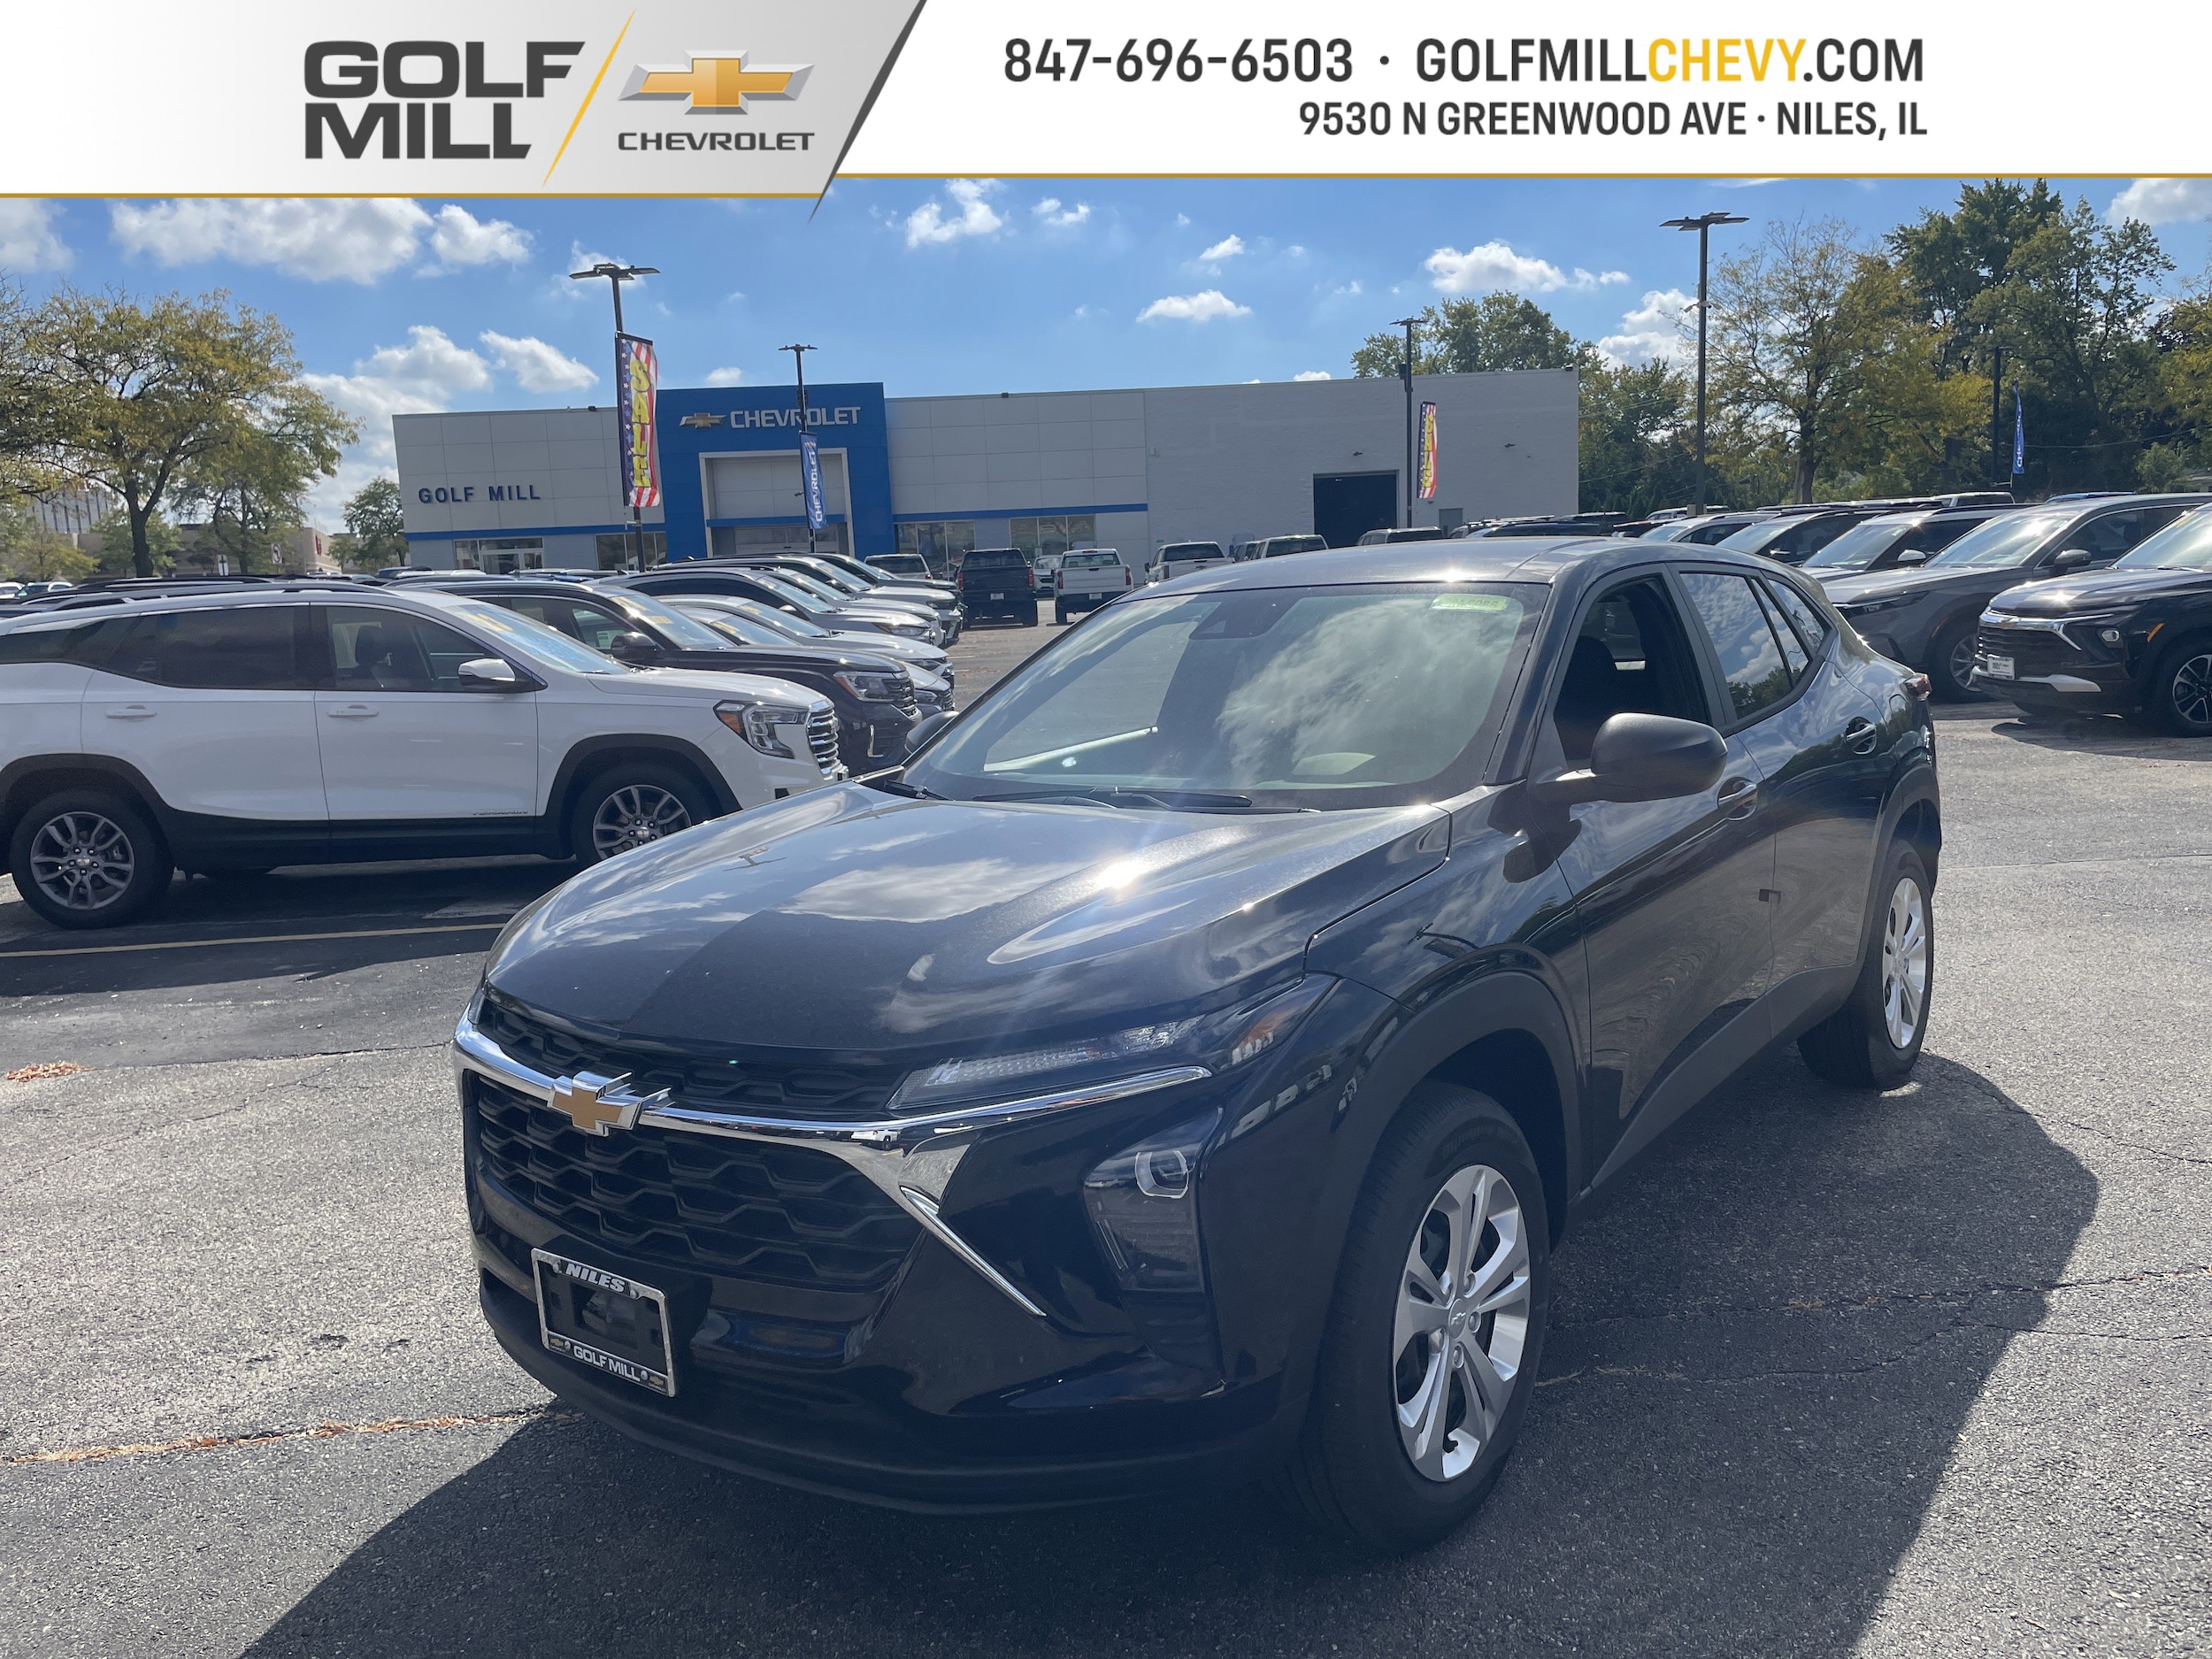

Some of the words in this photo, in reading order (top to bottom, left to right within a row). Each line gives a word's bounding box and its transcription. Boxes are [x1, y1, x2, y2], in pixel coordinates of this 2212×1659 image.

[630, 359, 651, 488] SALE
[730, 406, 862, 429] CHEVROLET
[418, 487, 474, 504] GOLF
[488, 485, 541, 502] MILL
[809, 451, 823, 522] CHEVROLET
[565, 1263, 626, 1293] NILES
[573, 1345, 608, 1369] GOLF
[609, 1359, 641, 1382] MILL
